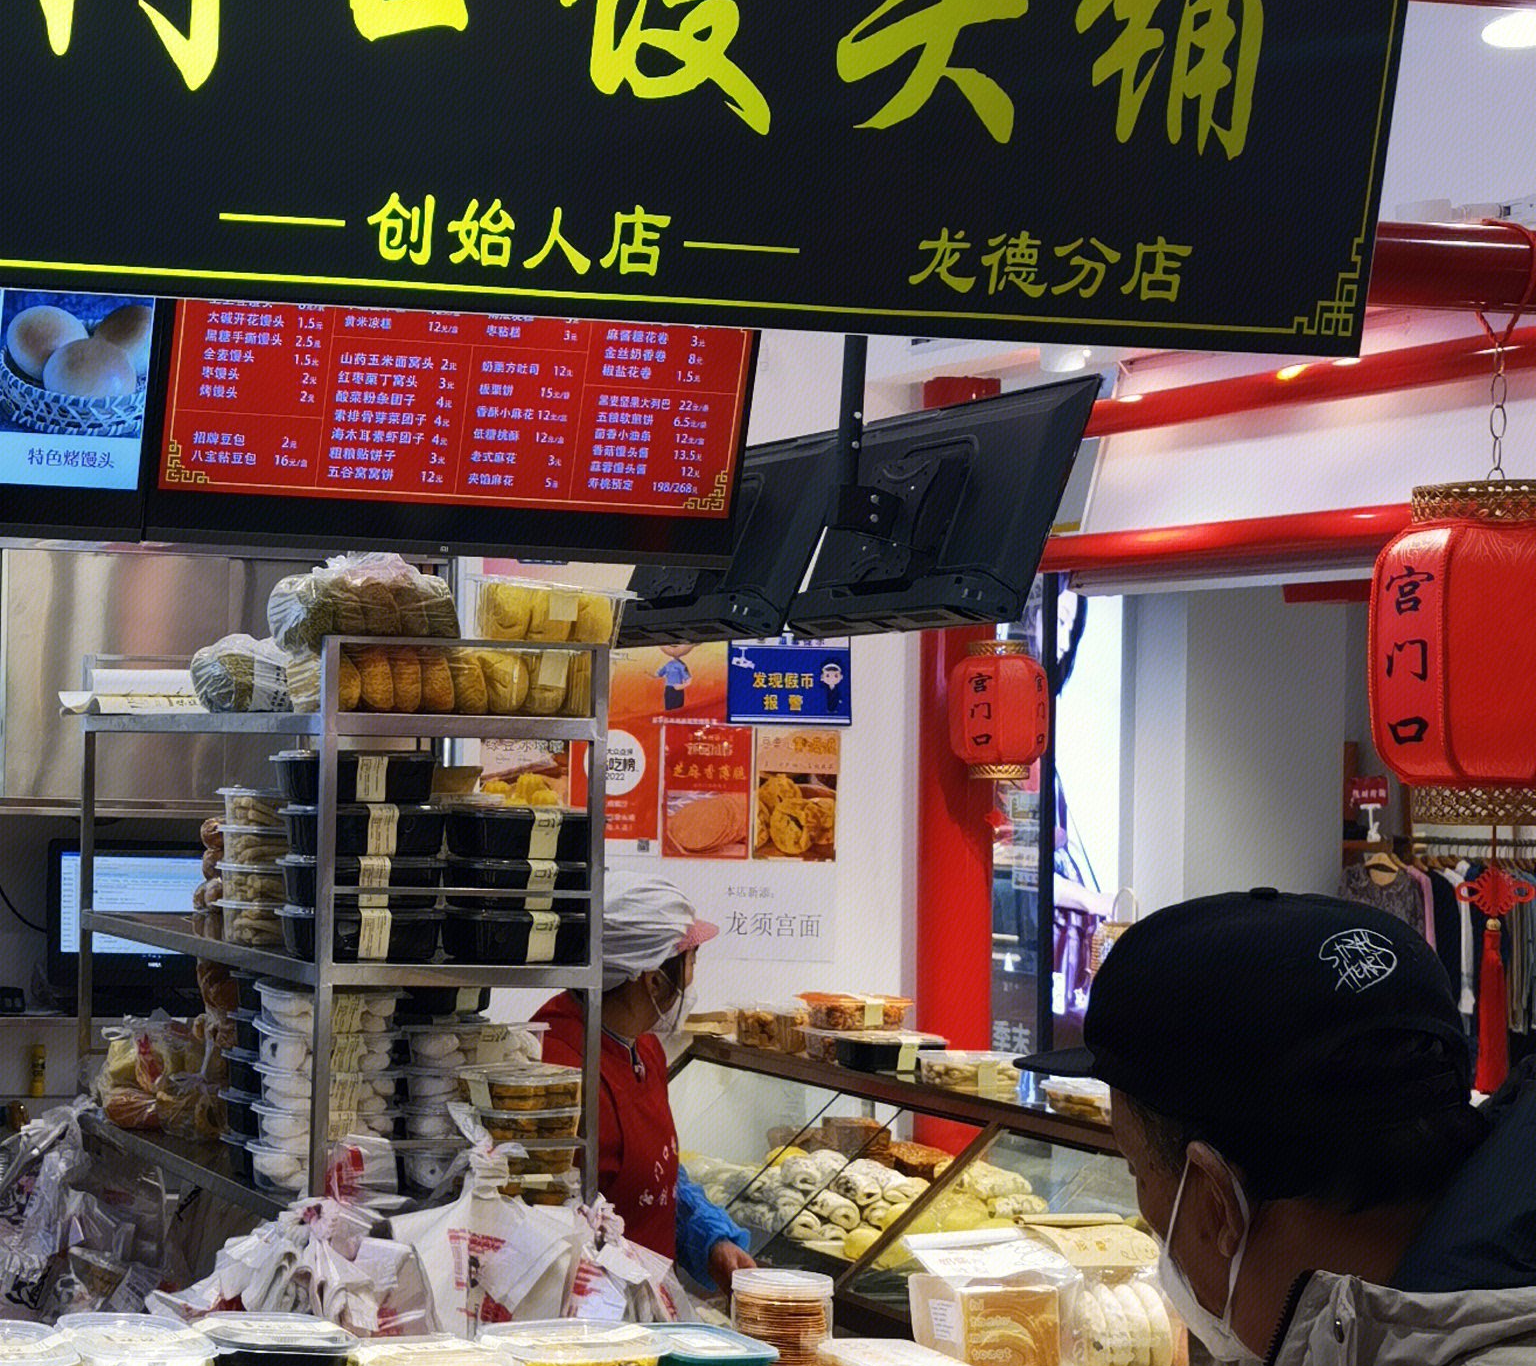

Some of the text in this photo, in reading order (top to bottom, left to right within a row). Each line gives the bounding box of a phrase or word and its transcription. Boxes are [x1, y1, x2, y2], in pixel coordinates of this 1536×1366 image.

[366, 191, 672, 280] 创始人店
[907, 227, 1194, 308] 龙德分店
[27, 446, 115, 471] 特色烤馒头
[753, 671, 814, 690] 发现假币
[1385, 566, 1435, 746] 宫门口
[763, 694, 804, 712] 报警
[968, 672, 993, 747] 宫门口
[724, 910, 824, 938] 龙须宫面
